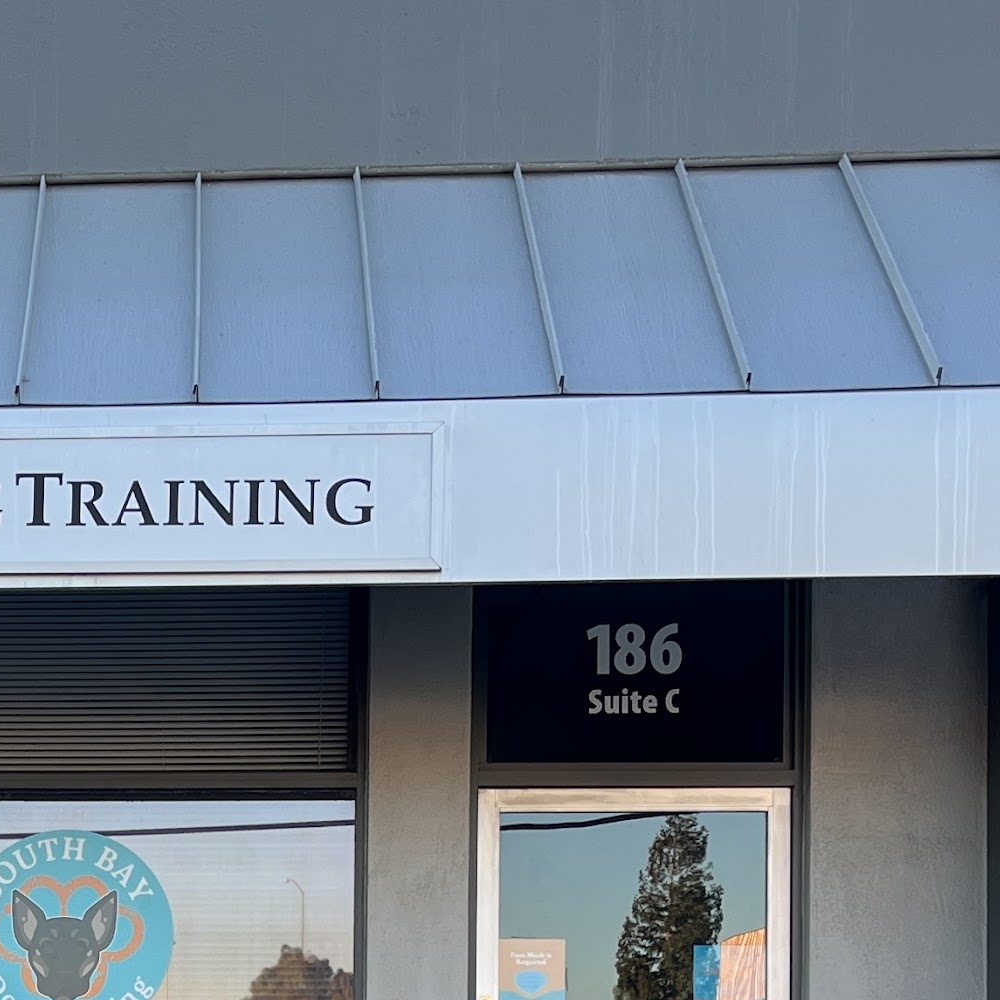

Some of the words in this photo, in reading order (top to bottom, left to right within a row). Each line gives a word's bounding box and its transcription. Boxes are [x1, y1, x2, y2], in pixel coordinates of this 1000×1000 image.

[15, 472, 375, 528] TRAINING
[586, 622, 683, 675] 186
[588, 688, 658, 715] Suite
[665, 688, 680, 714] C
[94, 845, 154, 902] BAY
